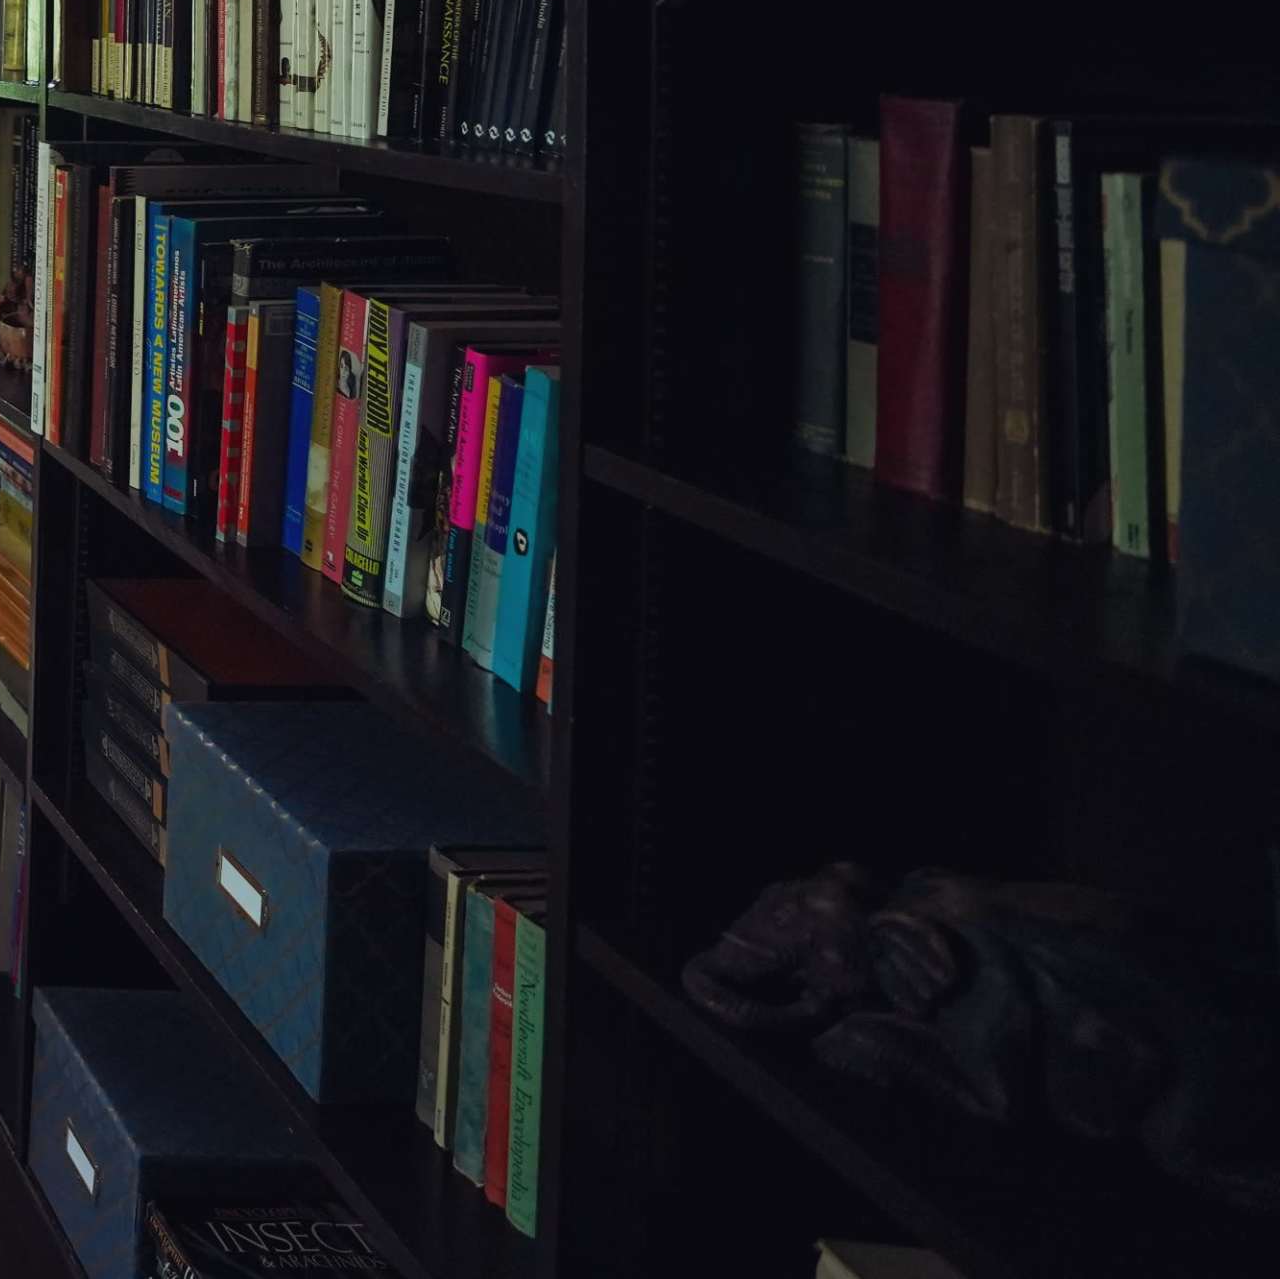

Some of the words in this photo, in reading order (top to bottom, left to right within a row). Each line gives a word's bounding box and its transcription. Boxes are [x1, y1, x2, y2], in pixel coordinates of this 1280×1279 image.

[154, 234, 168, 331] TOWARDS
[178, 270, 186, 307] Artists
[134, 318, 143, 376] PICASSO
[177, 310, 185, 363] American
[366, 300, 391, 354] HOLY
[152, 350, 164, 394] NEW
[366, 354, 393, 435] TERROR
[166, 393, 186, 457] 100
[336, 425, 345, 449] GIRL
[357, 426, 369, 454] Andy
[460, 404, 472, 433] sold
[149, 399, 163, 485] MUSEUM
[402, 420, 413, 465] MILLION
[456, 437, 469, 470] Andy
[357, 455, 370, 494] Warhol
[396, 469, 409, 515] STUFFED
[329, 494, 339, 539] GALLERY
[357, 495, 370, 526] Close
[393, 518, 403, 553] SHARK
[518, 974, 539, 1080] Needlecraft
[511, 1086, 534, 1201] Encyclopedia
[206, 1221, 374, 1254] INSECT
